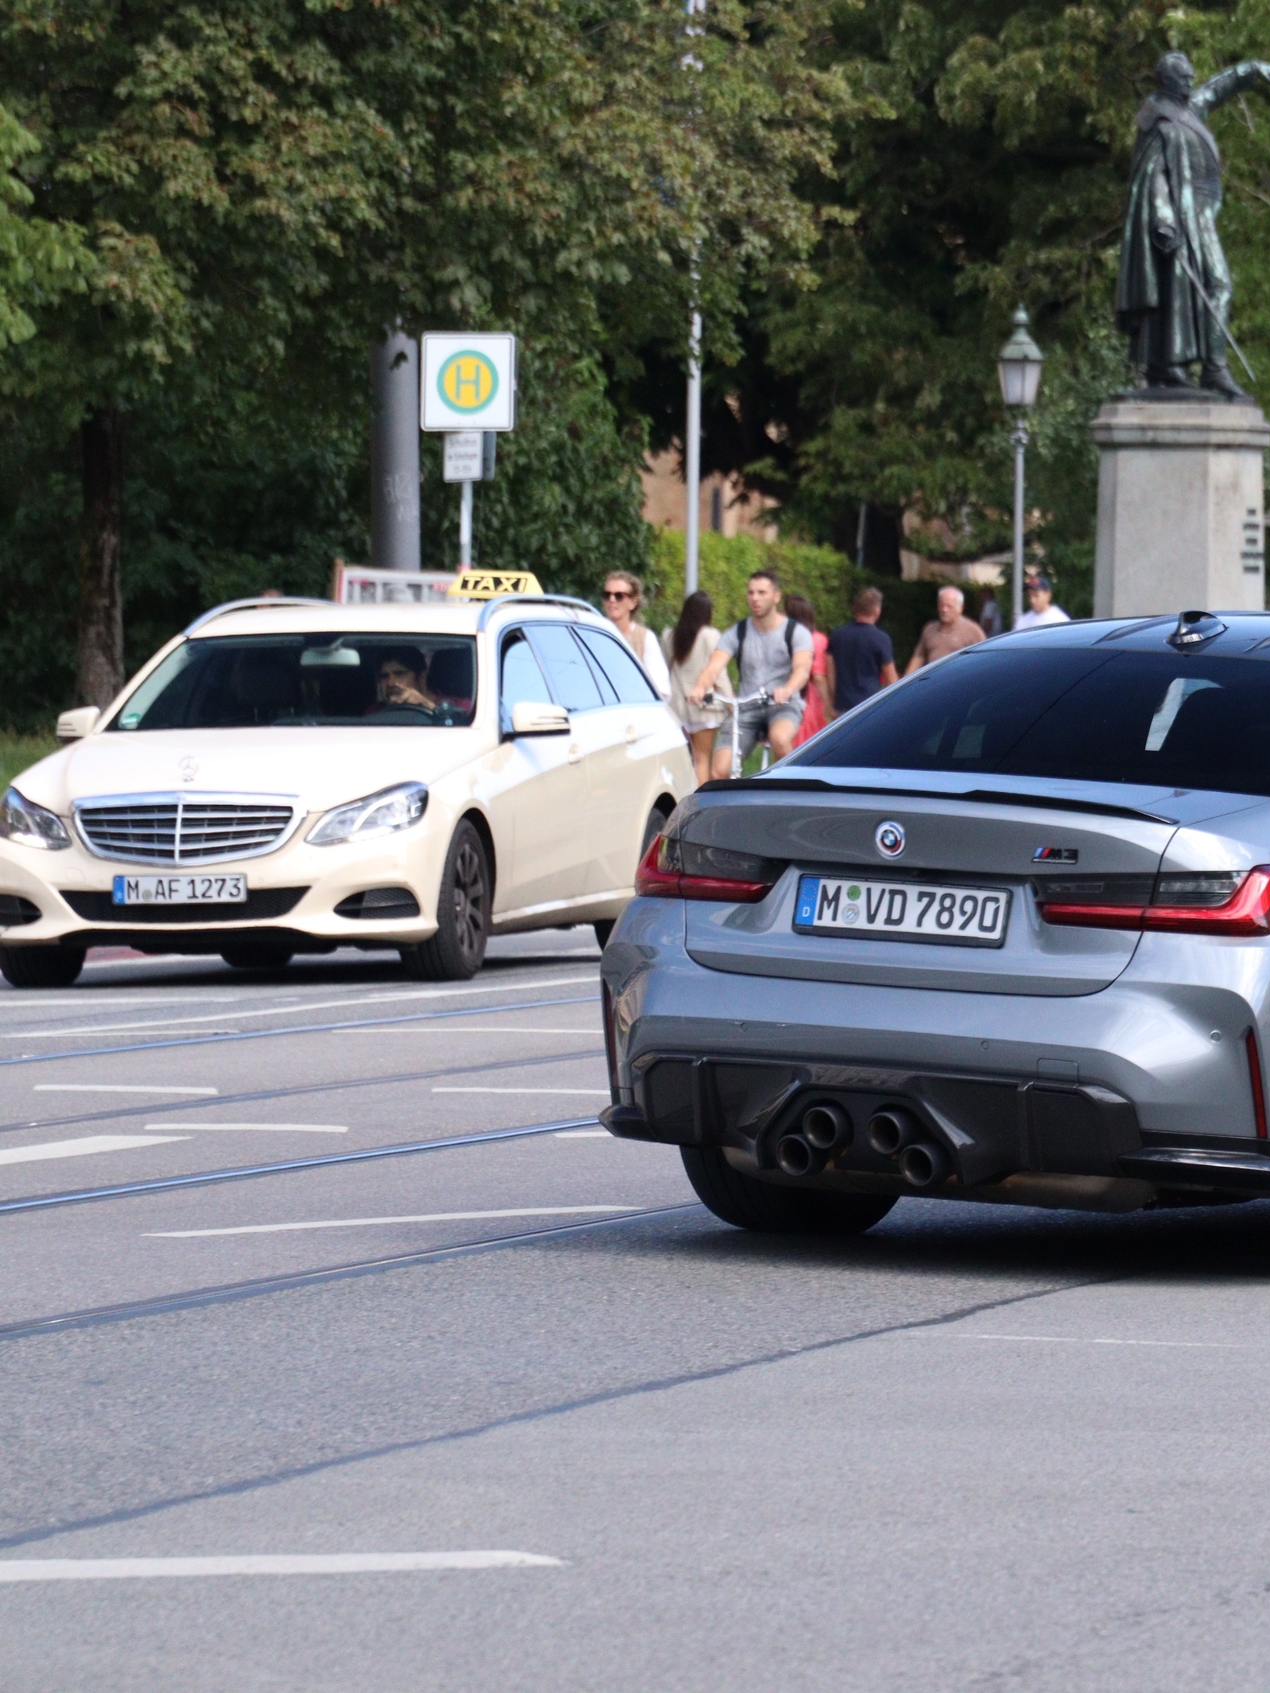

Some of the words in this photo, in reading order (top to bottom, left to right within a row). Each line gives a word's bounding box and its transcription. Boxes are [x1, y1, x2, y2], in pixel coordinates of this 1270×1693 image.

[456, 364, 481, 401] H
[464, 576, 527, 593] TAXI
[127, 880, 139, 900] M
[154, 879, 181, 900] AF
[187, 878, 241, 899] 1273
[817, 884, 842, 922] M
[866, 887, 908, 926] VD
[916, 891, 1000, 933] 7890
